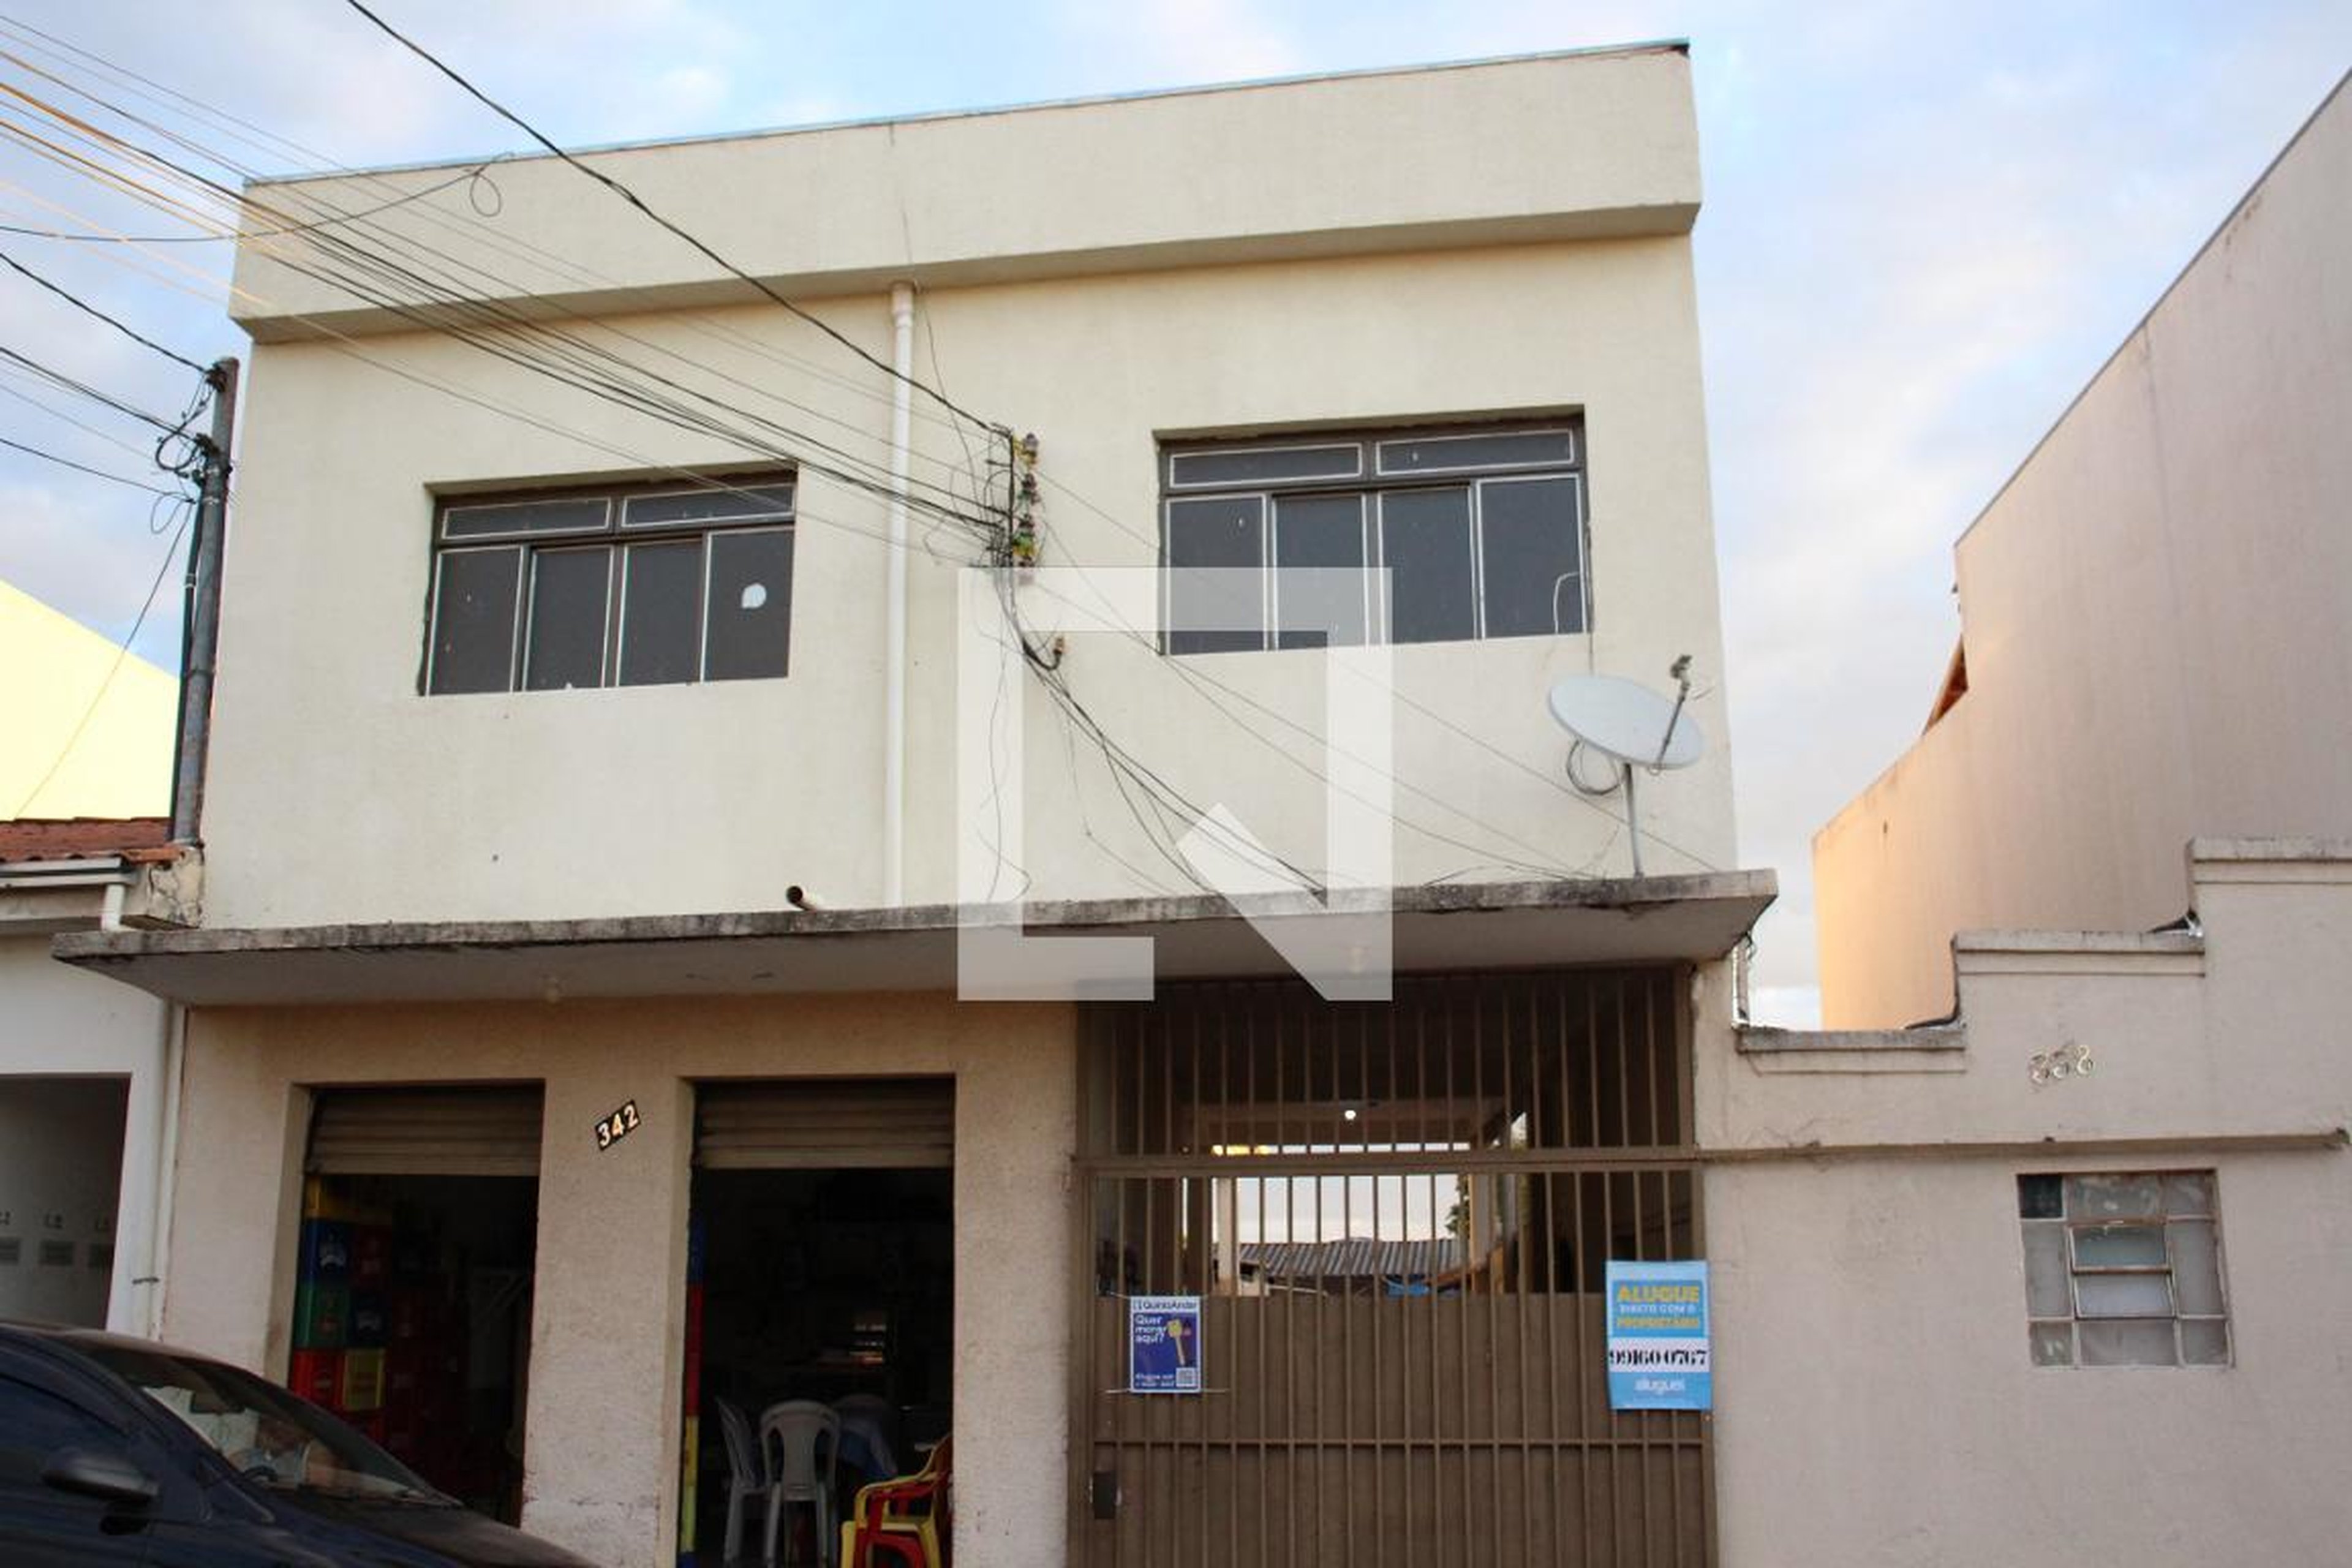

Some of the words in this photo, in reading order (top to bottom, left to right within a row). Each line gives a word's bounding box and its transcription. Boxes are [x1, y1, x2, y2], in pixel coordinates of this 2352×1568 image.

[597, 1104, 639, 1147] 342
[1617, 1285, 1699, 1303] ALUGUE
[1143, 1299, 1197, 1310] QuintoAndar
[1135, 1314, 1162, 1325] Quer
